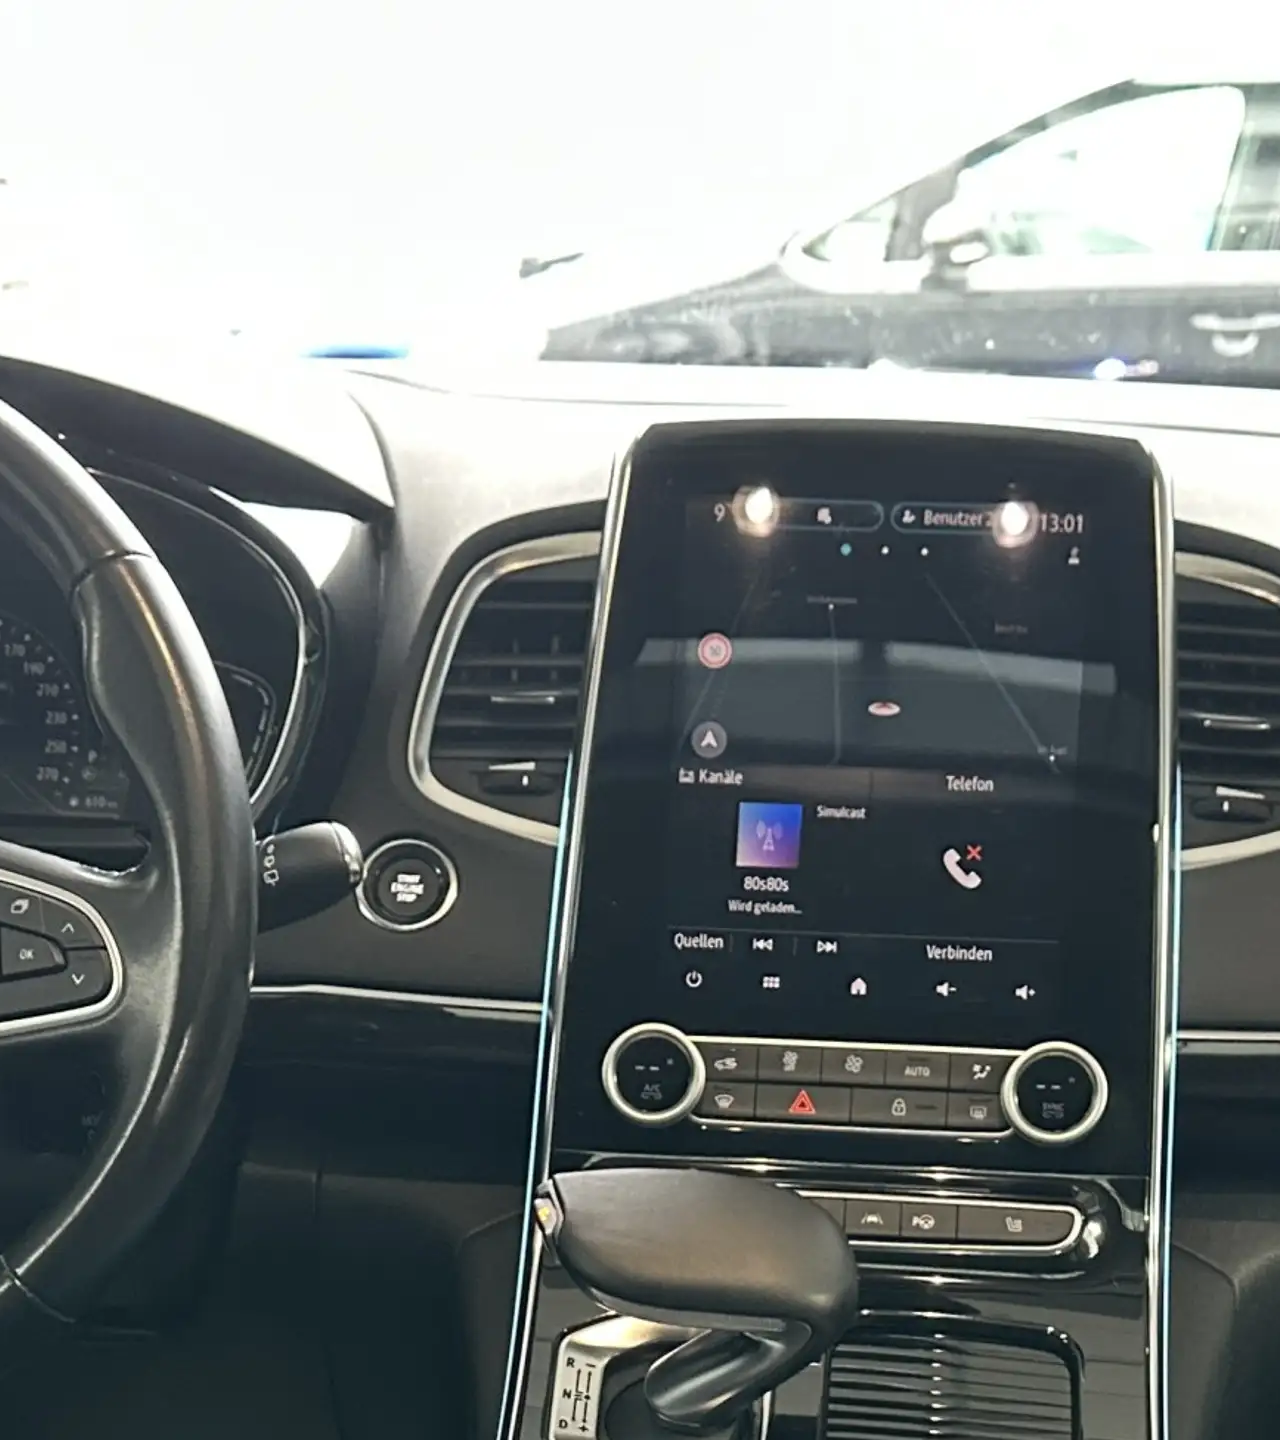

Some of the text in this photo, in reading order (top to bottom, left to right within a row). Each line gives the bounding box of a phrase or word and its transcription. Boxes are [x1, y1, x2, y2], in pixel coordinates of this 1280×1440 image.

[923, 509, 983, 526] Benutzer
[1040, 513, 1084, 533] 13:01
[699, 768, 744, 786] Kanäle
[945, 775, 995, 792] Telefon
[816, 804, 867, 820] Simulcast
[743, 875, 790, 892] 80s80s
[727, 899, 752, 913] Wird
[673, 932, 725, 950] Quellen
[19, 948, 34, 960] OK
[925, 944, 993, 961] Verbinden
[904, 1065, 931, 1077] AUTO
[566, 1357, 575, 1368] R
[562, 1388, 572, 1399] N
[558, 1418, 568, 1429] D
